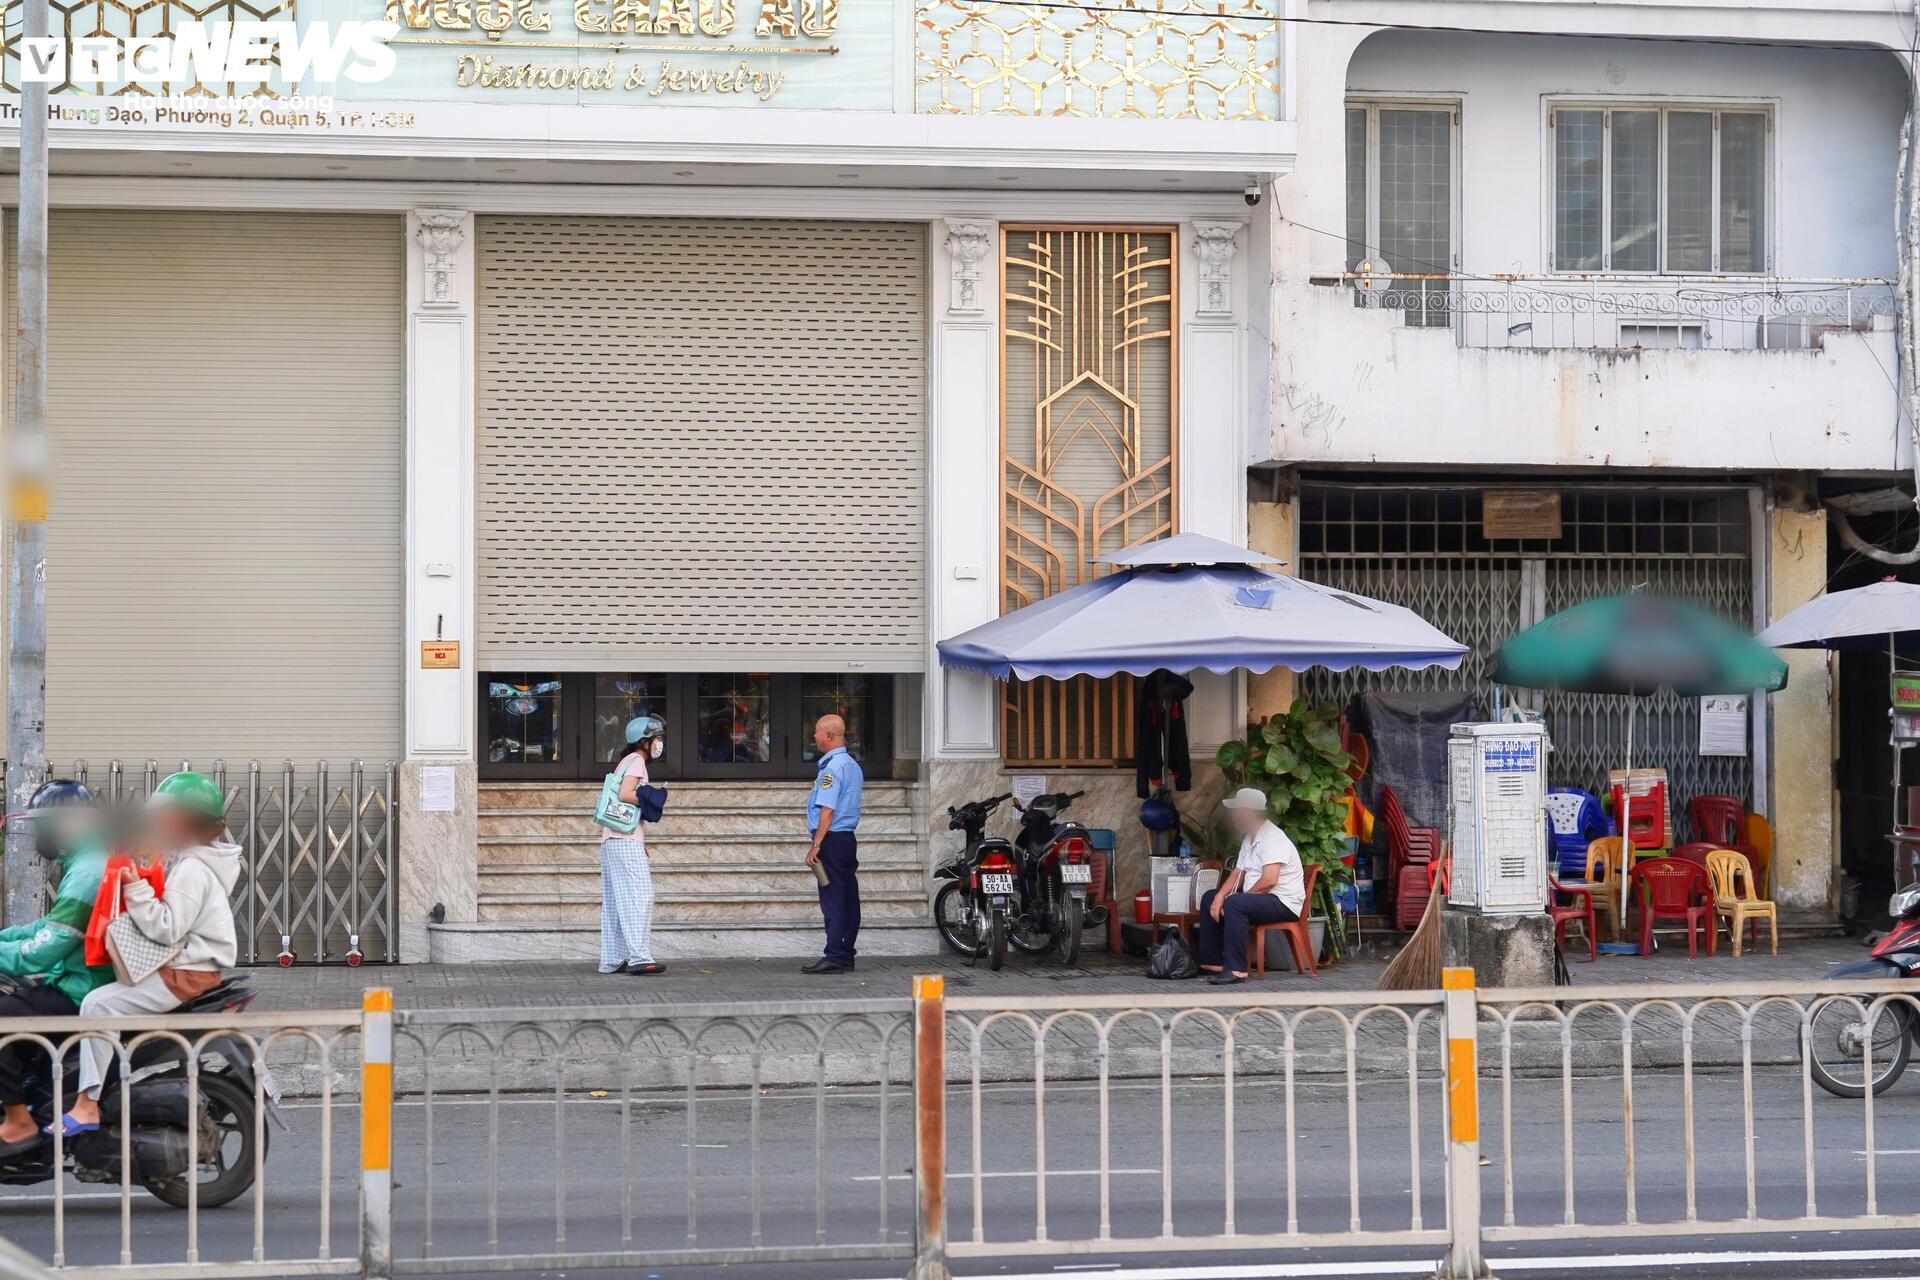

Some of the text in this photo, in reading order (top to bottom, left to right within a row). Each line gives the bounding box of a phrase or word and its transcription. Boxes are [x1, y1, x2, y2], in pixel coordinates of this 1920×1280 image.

[457, 53, 785, 101] Diamond & Jewelry
[106, 106, 148, 125] Đạo,
[155, 107, 232, 127] Phường
[238, 109, 254, 127] 2,
[259, 109, 310, 129] Quận
[315, 111, 332, 128] 5,
[986, 874, 1009, 883] 50-AA
[985, 883, 1012, 892] 562.49
